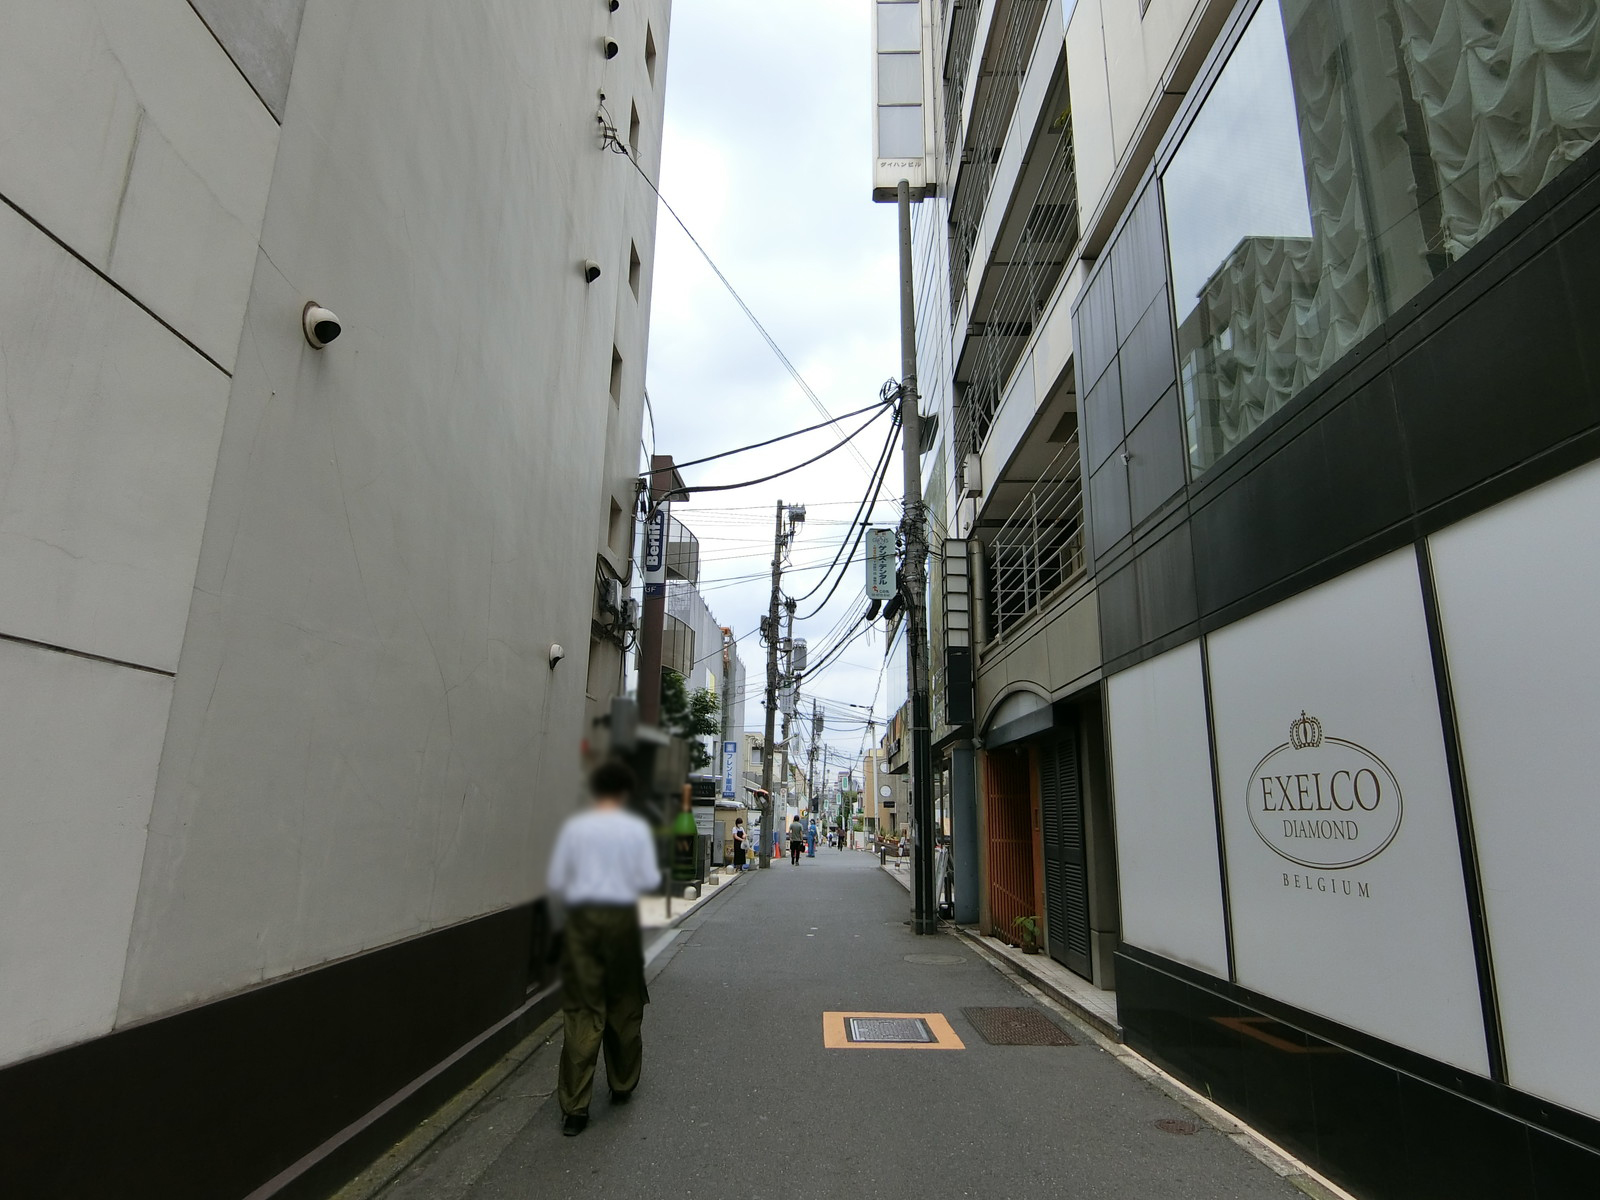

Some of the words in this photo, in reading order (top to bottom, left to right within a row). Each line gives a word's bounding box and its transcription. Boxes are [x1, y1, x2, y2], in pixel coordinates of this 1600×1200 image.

[1260, 768, 1381, 811] EXELCO
[1283, 819, 1359, 841] DIAMOND
[1282, 873, 1370, 898] BELGIUM
